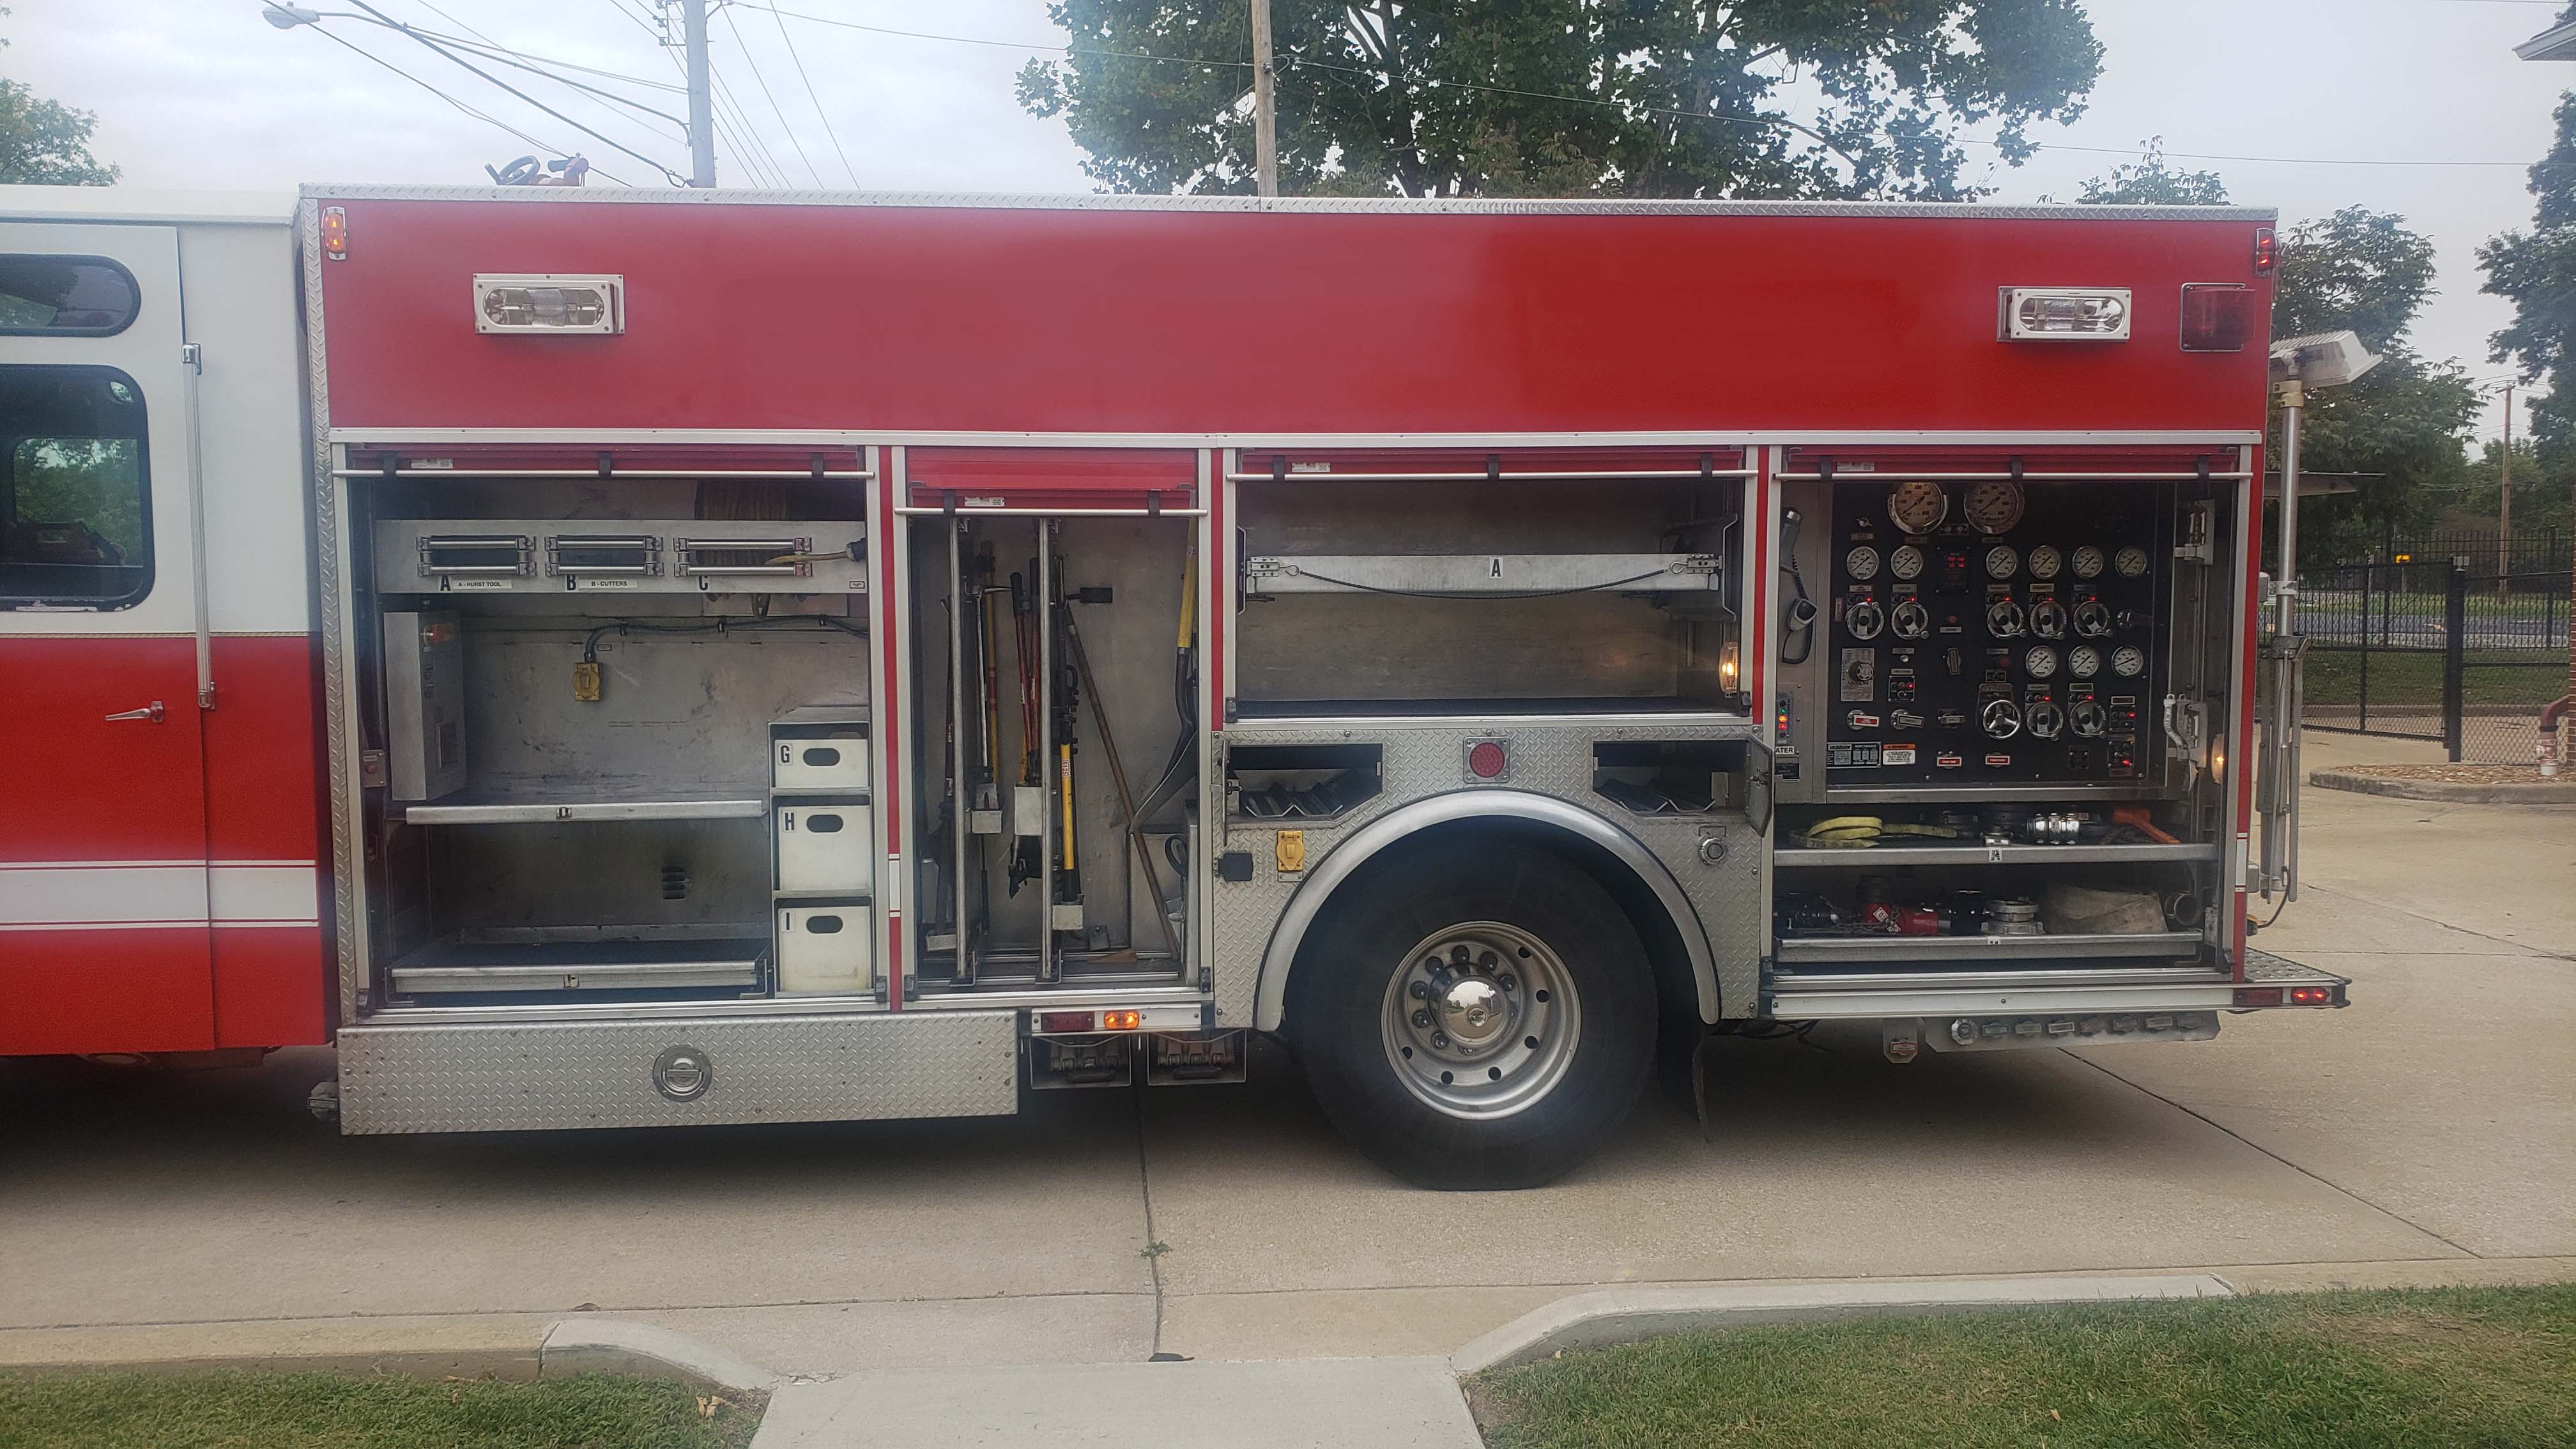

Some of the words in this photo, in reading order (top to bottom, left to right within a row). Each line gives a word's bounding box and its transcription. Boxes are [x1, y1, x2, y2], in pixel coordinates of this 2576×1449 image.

[1491, 559, 1501, 577] A
[440, 576, 450, 591] A
[567, 575, 576, 590] B
[781, 746, 790, 763] G
[785, 813, 794, 831] H
[786, 912, 790, 930] I
